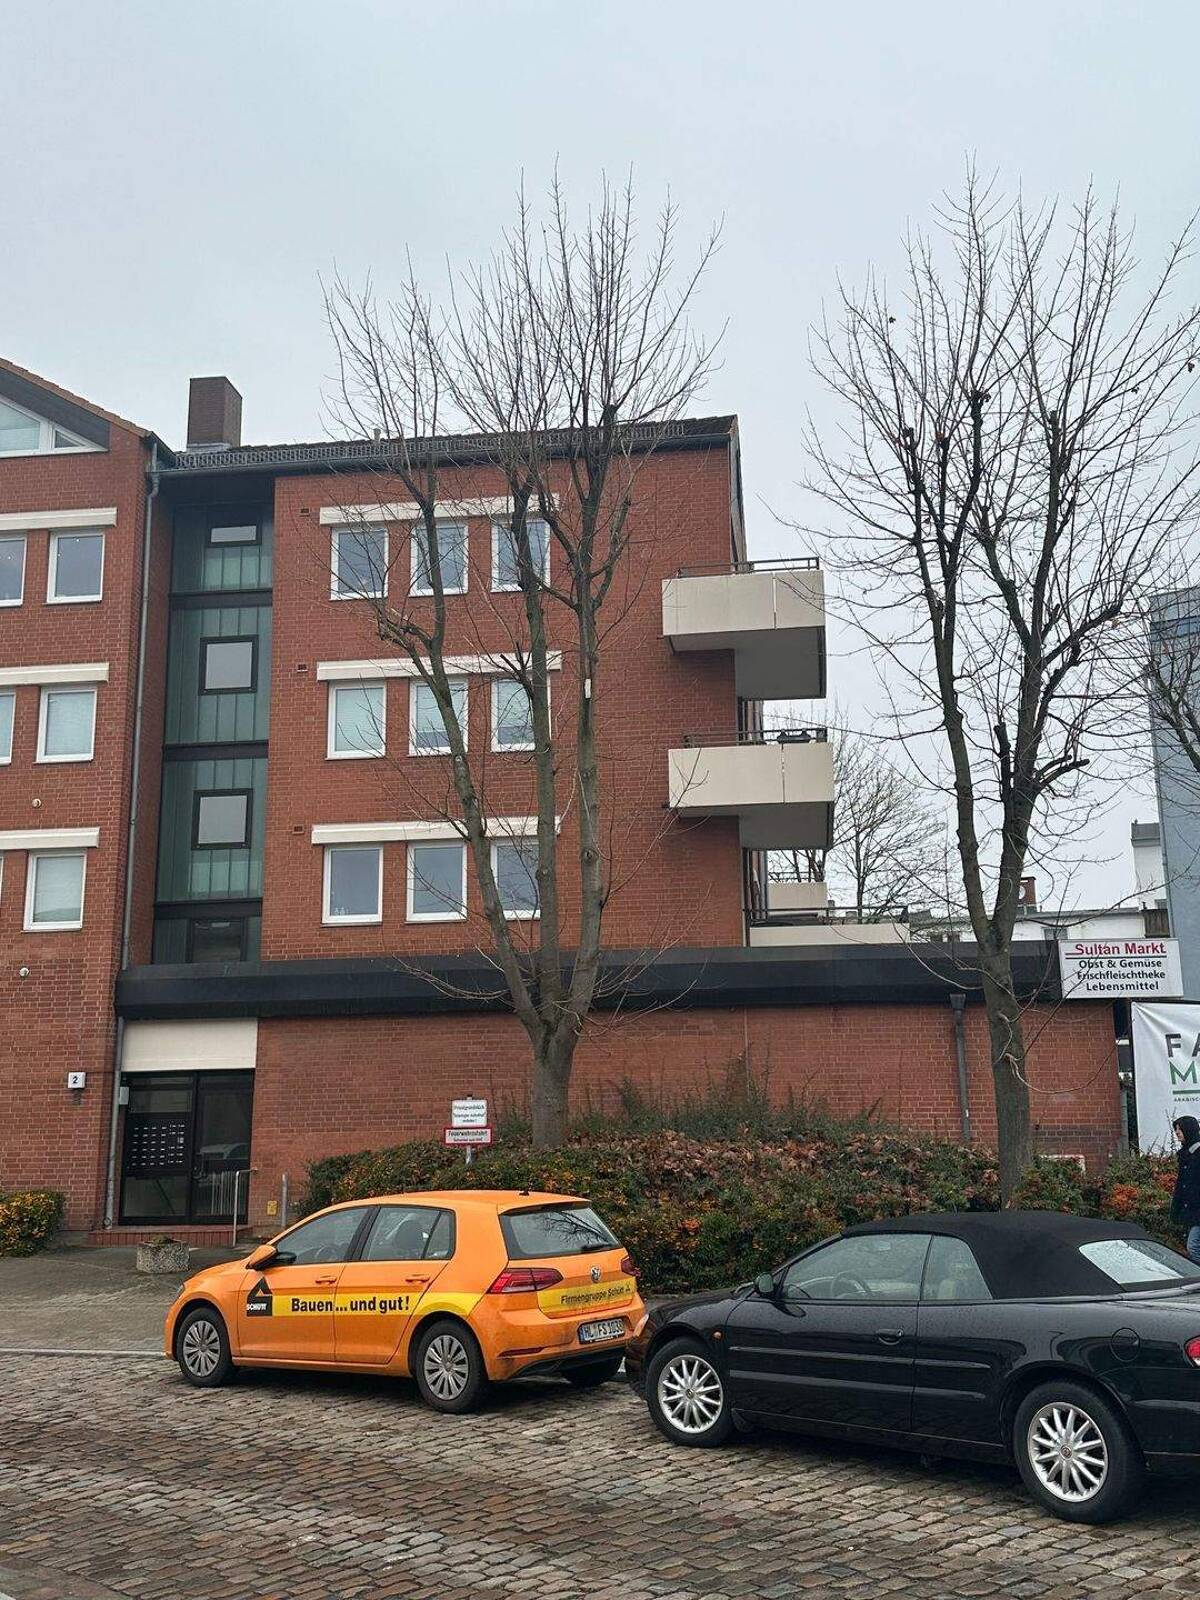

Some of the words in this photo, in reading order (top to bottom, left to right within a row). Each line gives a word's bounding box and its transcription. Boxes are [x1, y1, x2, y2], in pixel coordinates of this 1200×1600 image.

[1075, 943, 1120, 955] Sultan
[1125, 942, 1167, 954] Markt
[1079, 959, 1104, 969] Obst
[1107, 960, 1116, 968] &
[1120, 959, 1162, 968] Gemüse
[1077, 970, 1166, 980] Frischfleischtheke
[1086, 981, 1159, 991] Lebensmittel
[73, 1076, 79, 1084] 2
[380, 1296, 410, 1314] gut!
